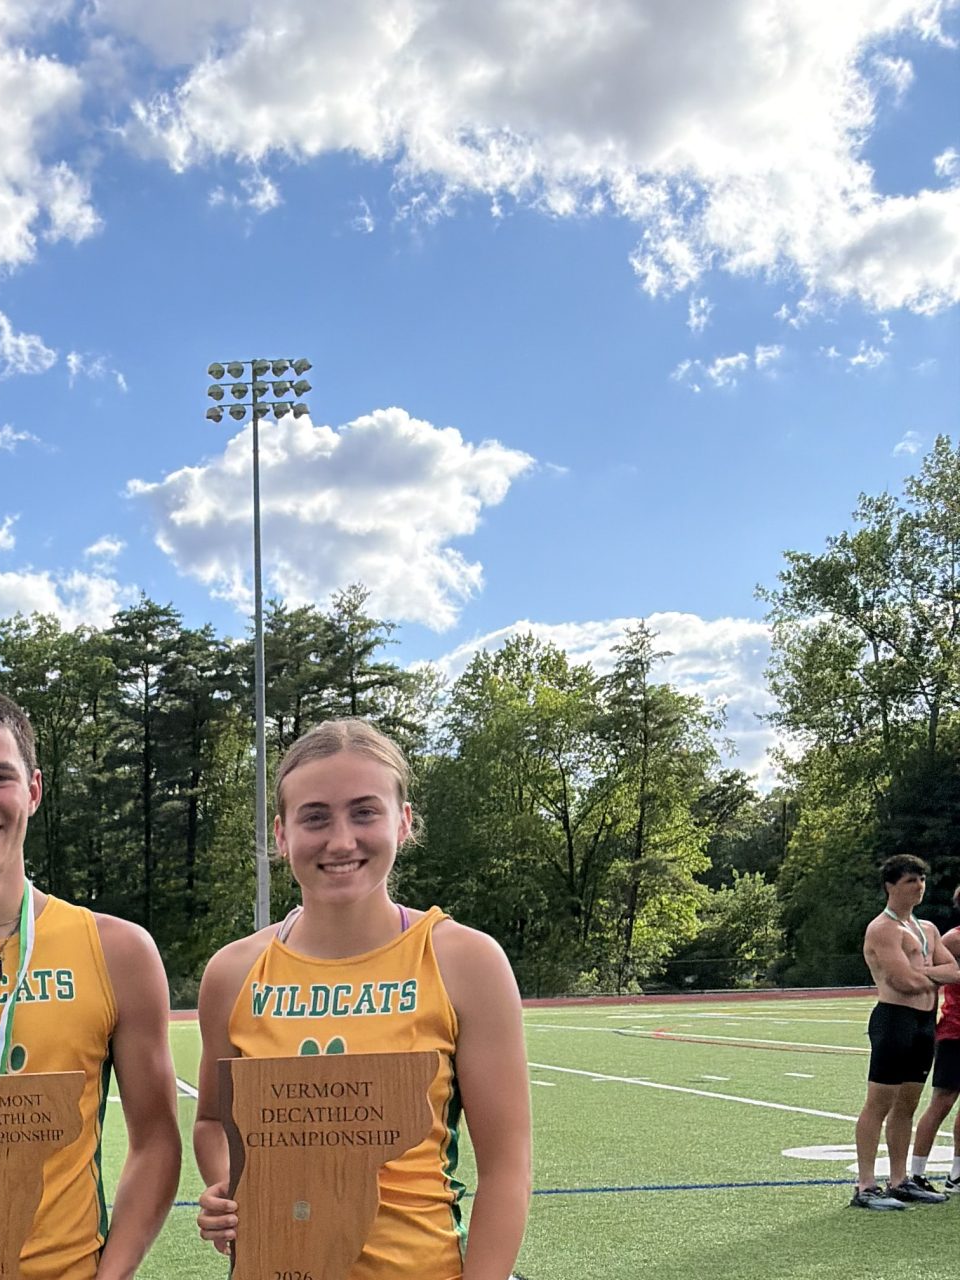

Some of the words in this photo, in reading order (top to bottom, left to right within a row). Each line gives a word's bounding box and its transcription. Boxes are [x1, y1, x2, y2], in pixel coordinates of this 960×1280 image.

[252, 979, 417, 1018] WILDCATS
[271, 1081, 373, 1099] VERMONT
[261, 1105, 384, 1124] DECATHLON
[246, 1129, 401, 1148] CHAMPIONSHIP
